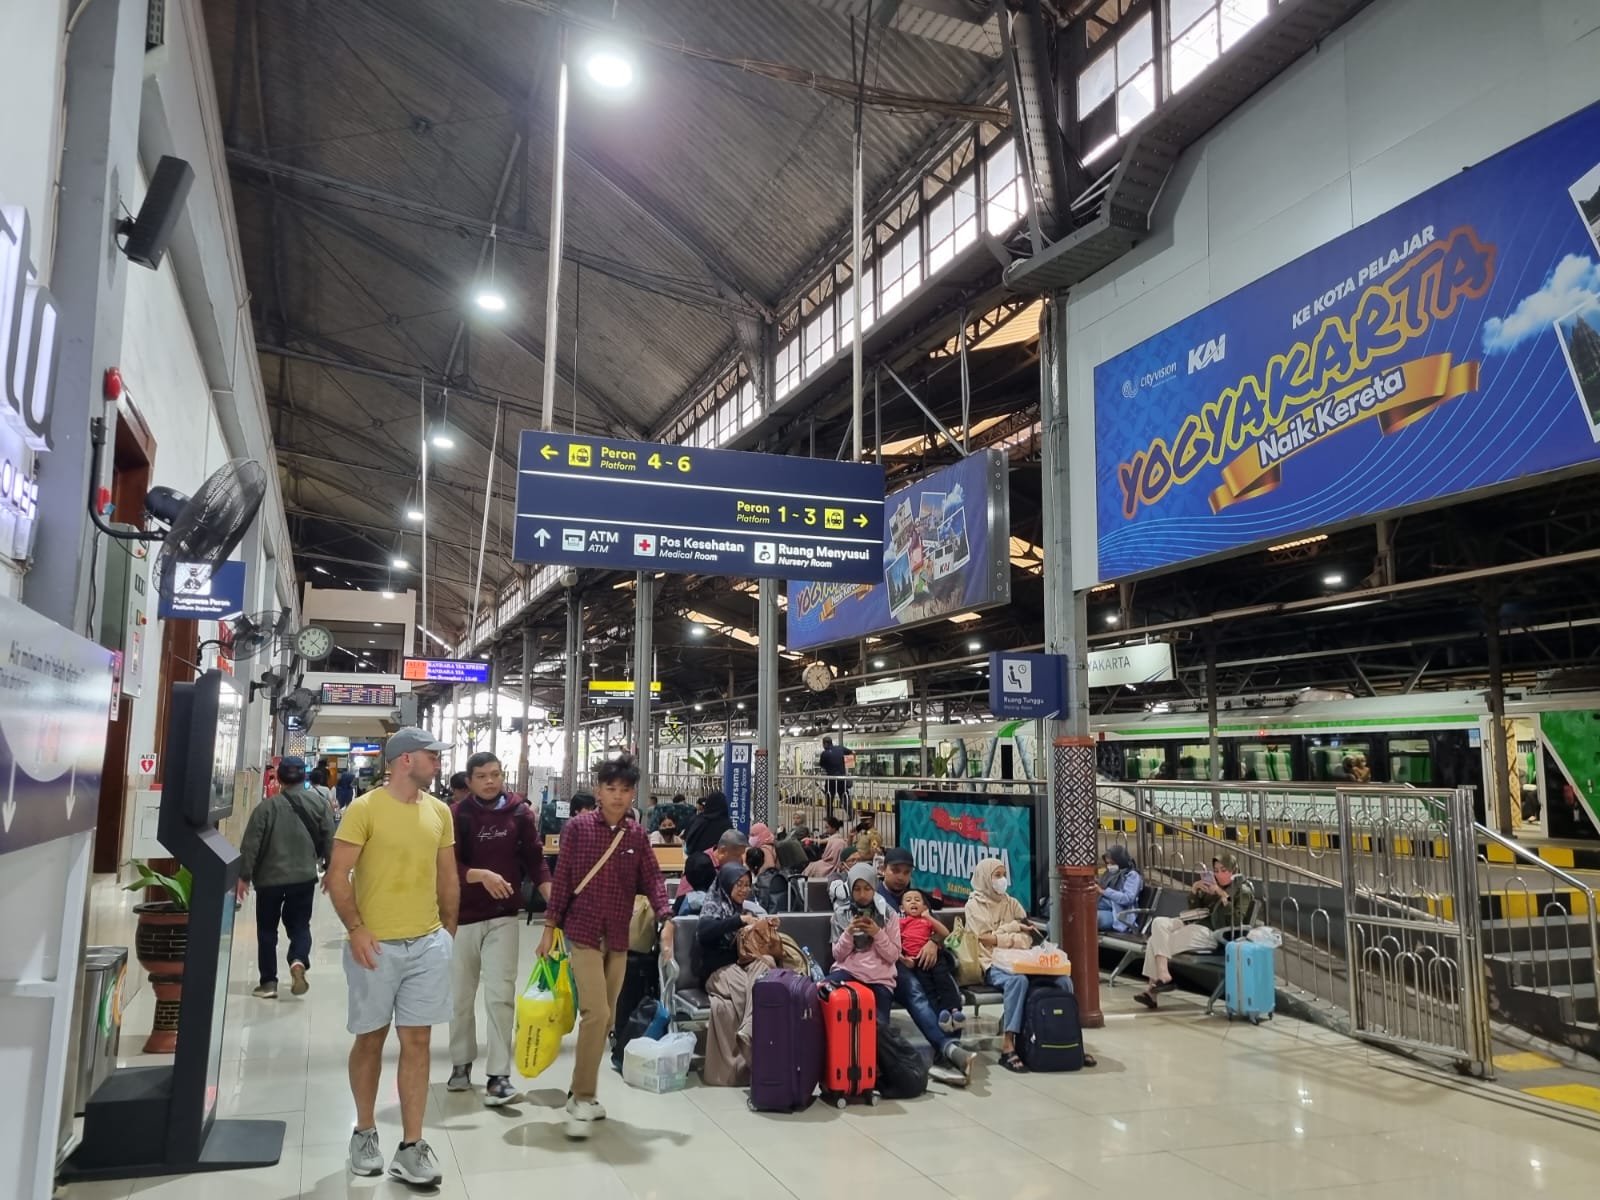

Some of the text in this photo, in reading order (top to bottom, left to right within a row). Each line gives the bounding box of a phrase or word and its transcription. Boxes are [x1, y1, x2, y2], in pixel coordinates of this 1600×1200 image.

[1292, 225, 1435, 330] KE KOTA PELAJAR
[1188, 333, 1226, 375] KAI
[1118, 226, 1497, 519] YOGYAKARTA
[1140, 362, 1177, 388] cityvision
[1258, 370, 1404, 467] Naik Kereta
[600, 460, 637, 471] Platform
[601, 446, 637, 460] Peron
[647, 452, 661, 470] 4
[677, 455, 691, 472] 6
[736, 514, 770, 525] Platform
[737, 501, 770, 514] Peron
[778, 506, 786, 523] 1
[804, 508, 817, 525] 3
[589, 530, 619, 543] ATM
[660, 536, 745, 552] Pos Kesehatan
[588, 544, 609, 553] ATM
[659, 550, 718, 561] Medical Room
[779, 543, 870, 561] Ruang Menyusui
[778, 557, 833, 568] Nursery Room
[1087, 655, 1131, 673] YAKARTA
[1003, 696, 1021, 705] Ruang
[730, 767, 740, 830] erja Bersama
[740, 787, 748, 824] Co-working
